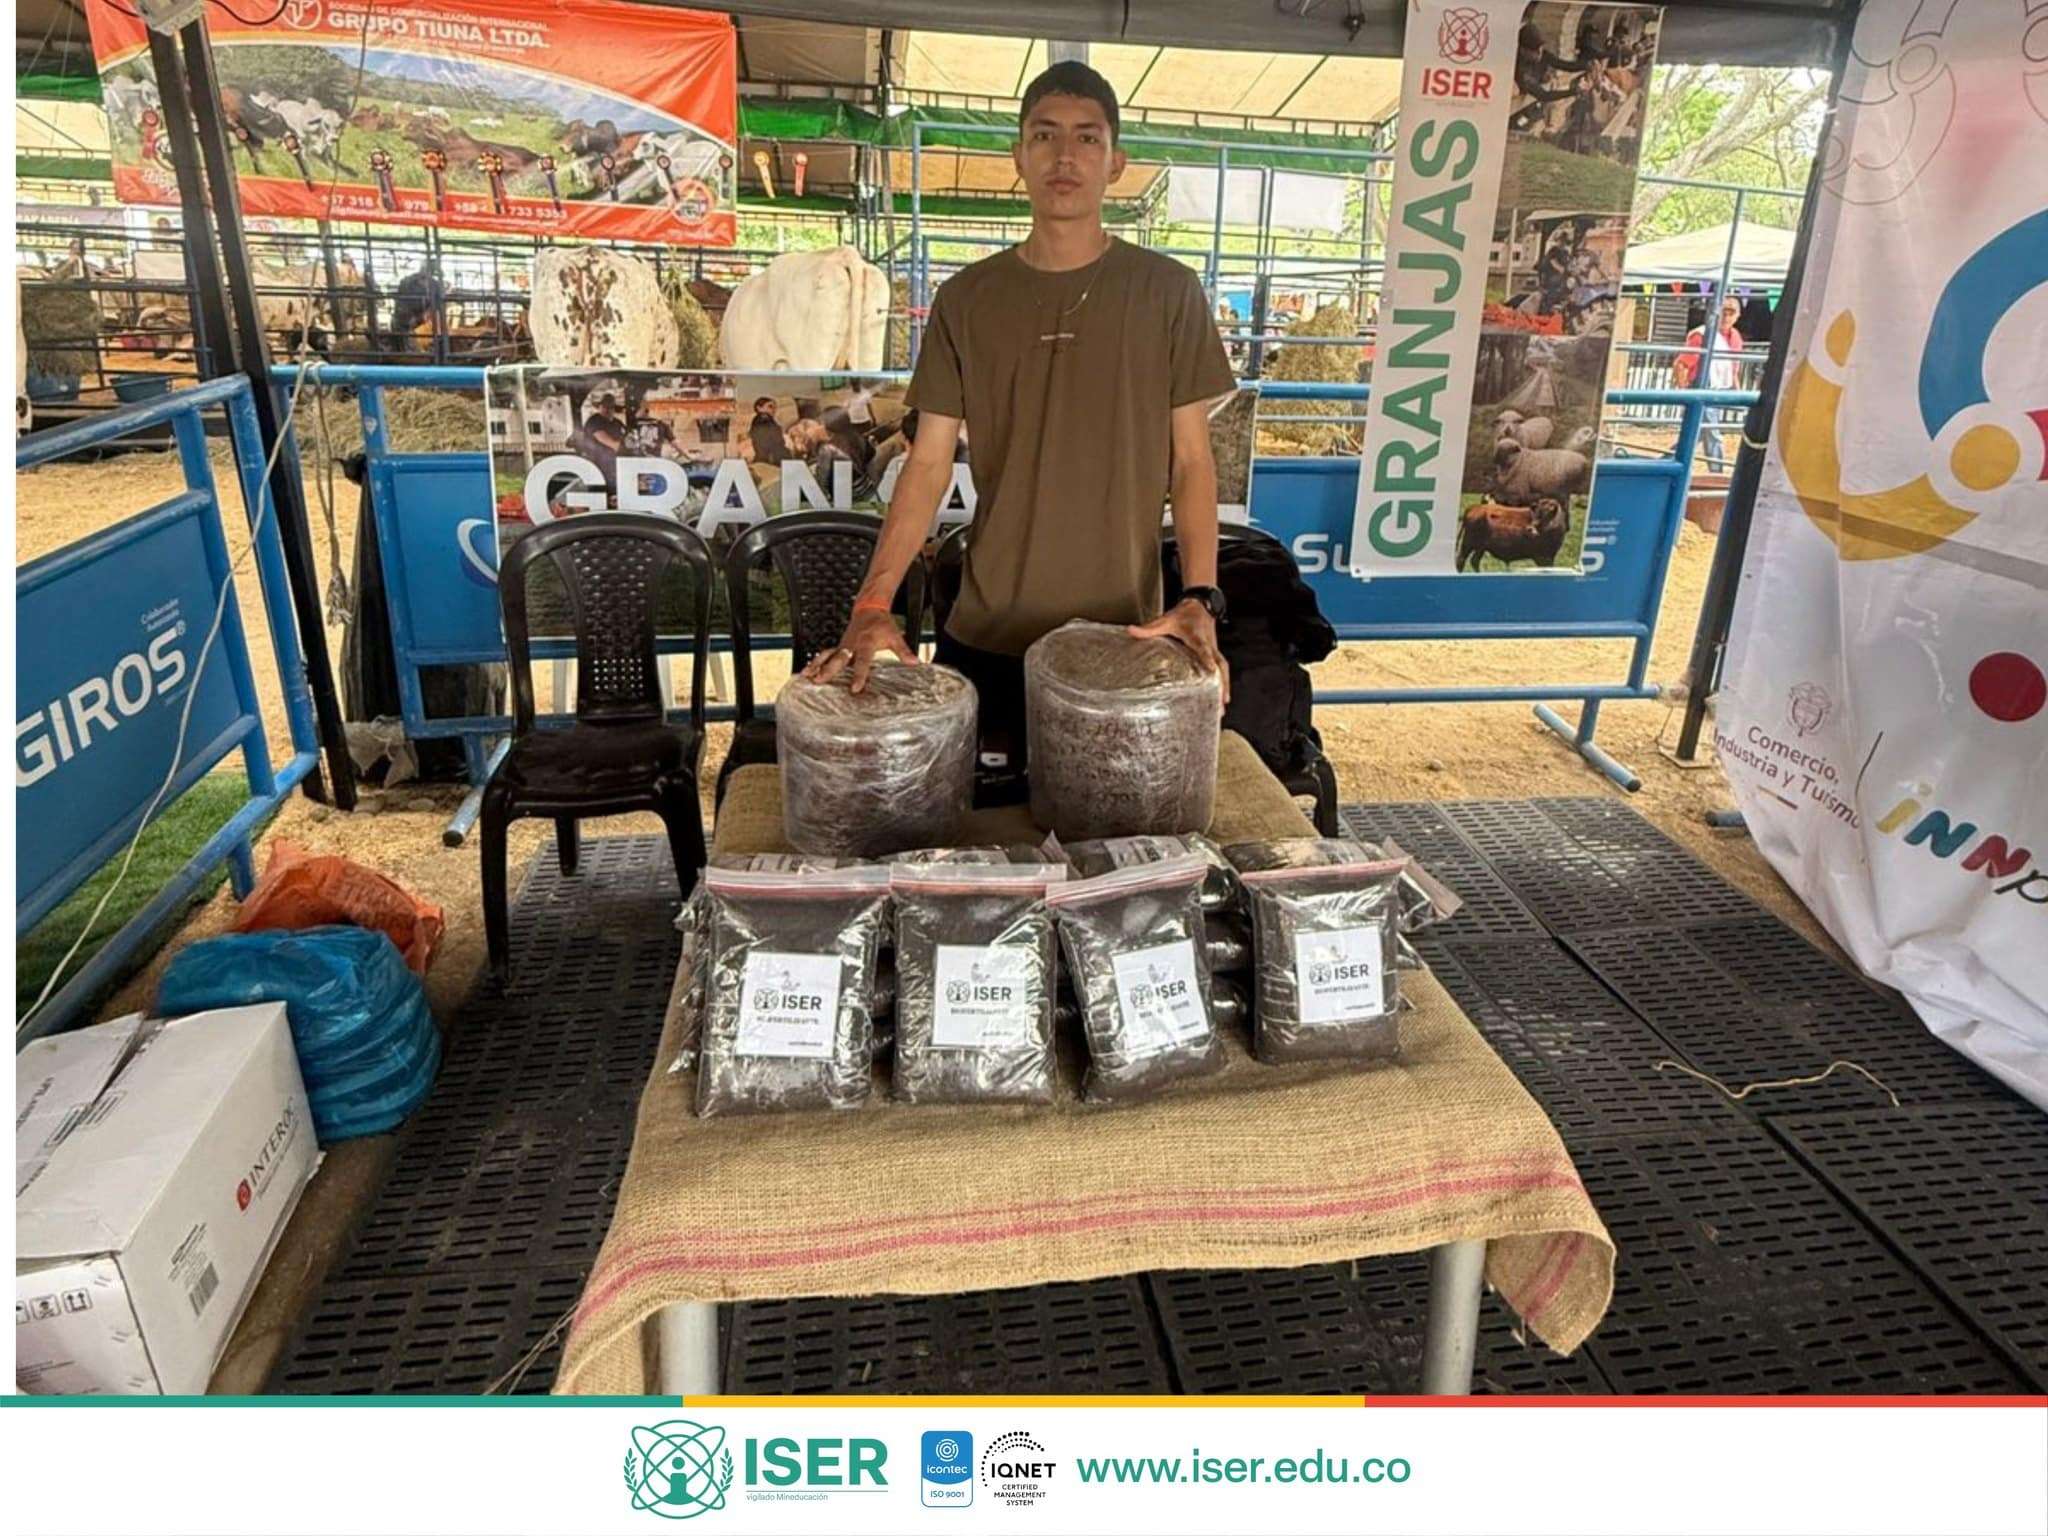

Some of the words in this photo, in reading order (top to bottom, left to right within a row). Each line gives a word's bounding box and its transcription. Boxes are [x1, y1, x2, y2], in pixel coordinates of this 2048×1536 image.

[328, 11, 408, 34] GRUPO
[415, 19, 484, 42] TIUNA
[489, 27, 551, 48] LTDA.
[1422, 67, 1491, 99] ISER
[1368, 119, 1480, 558] GRANJAS
[1713, 727, 1778, 779] Industria
[1782, 769, 1796, 788] y
[1748, 726, 1839, 784] Comercio,
[1334, 963, 1369, 981] ISER
[781, 994, 823, 1011] ISER
[974, 986, 1012, 1001] ISER
